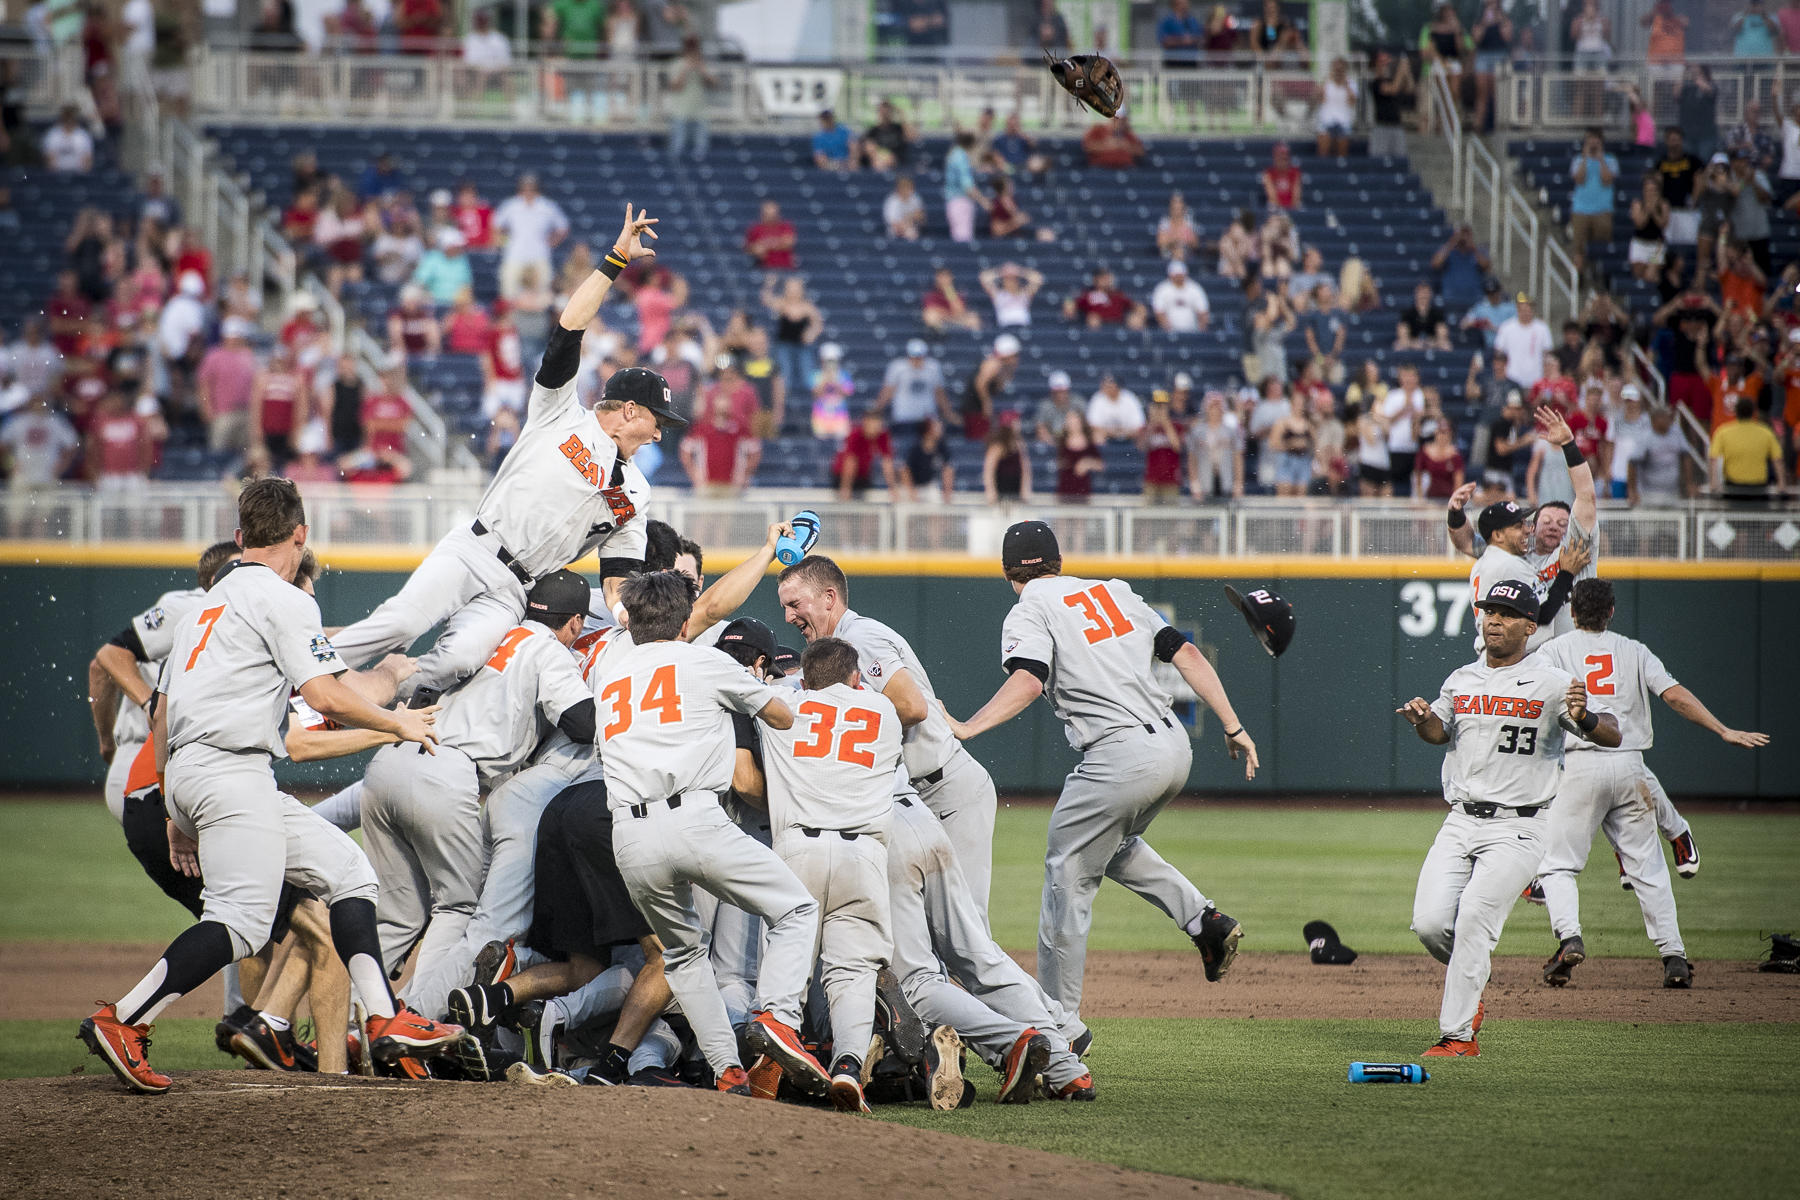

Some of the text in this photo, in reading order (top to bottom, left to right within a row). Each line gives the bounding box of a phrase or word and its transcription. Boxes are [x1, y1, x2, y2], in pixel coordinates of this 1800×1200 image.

[1062, 582, 1136, 646] 31
[1490, 585, 1521, 600] OSU
[184, 603, 228, 673] 7
[600, 663, 684, 744] 34
[1584, 653, 1615, 696] 2
[792, 699, 882, 770] 32
[1497, 724, 1539, 756] 33
